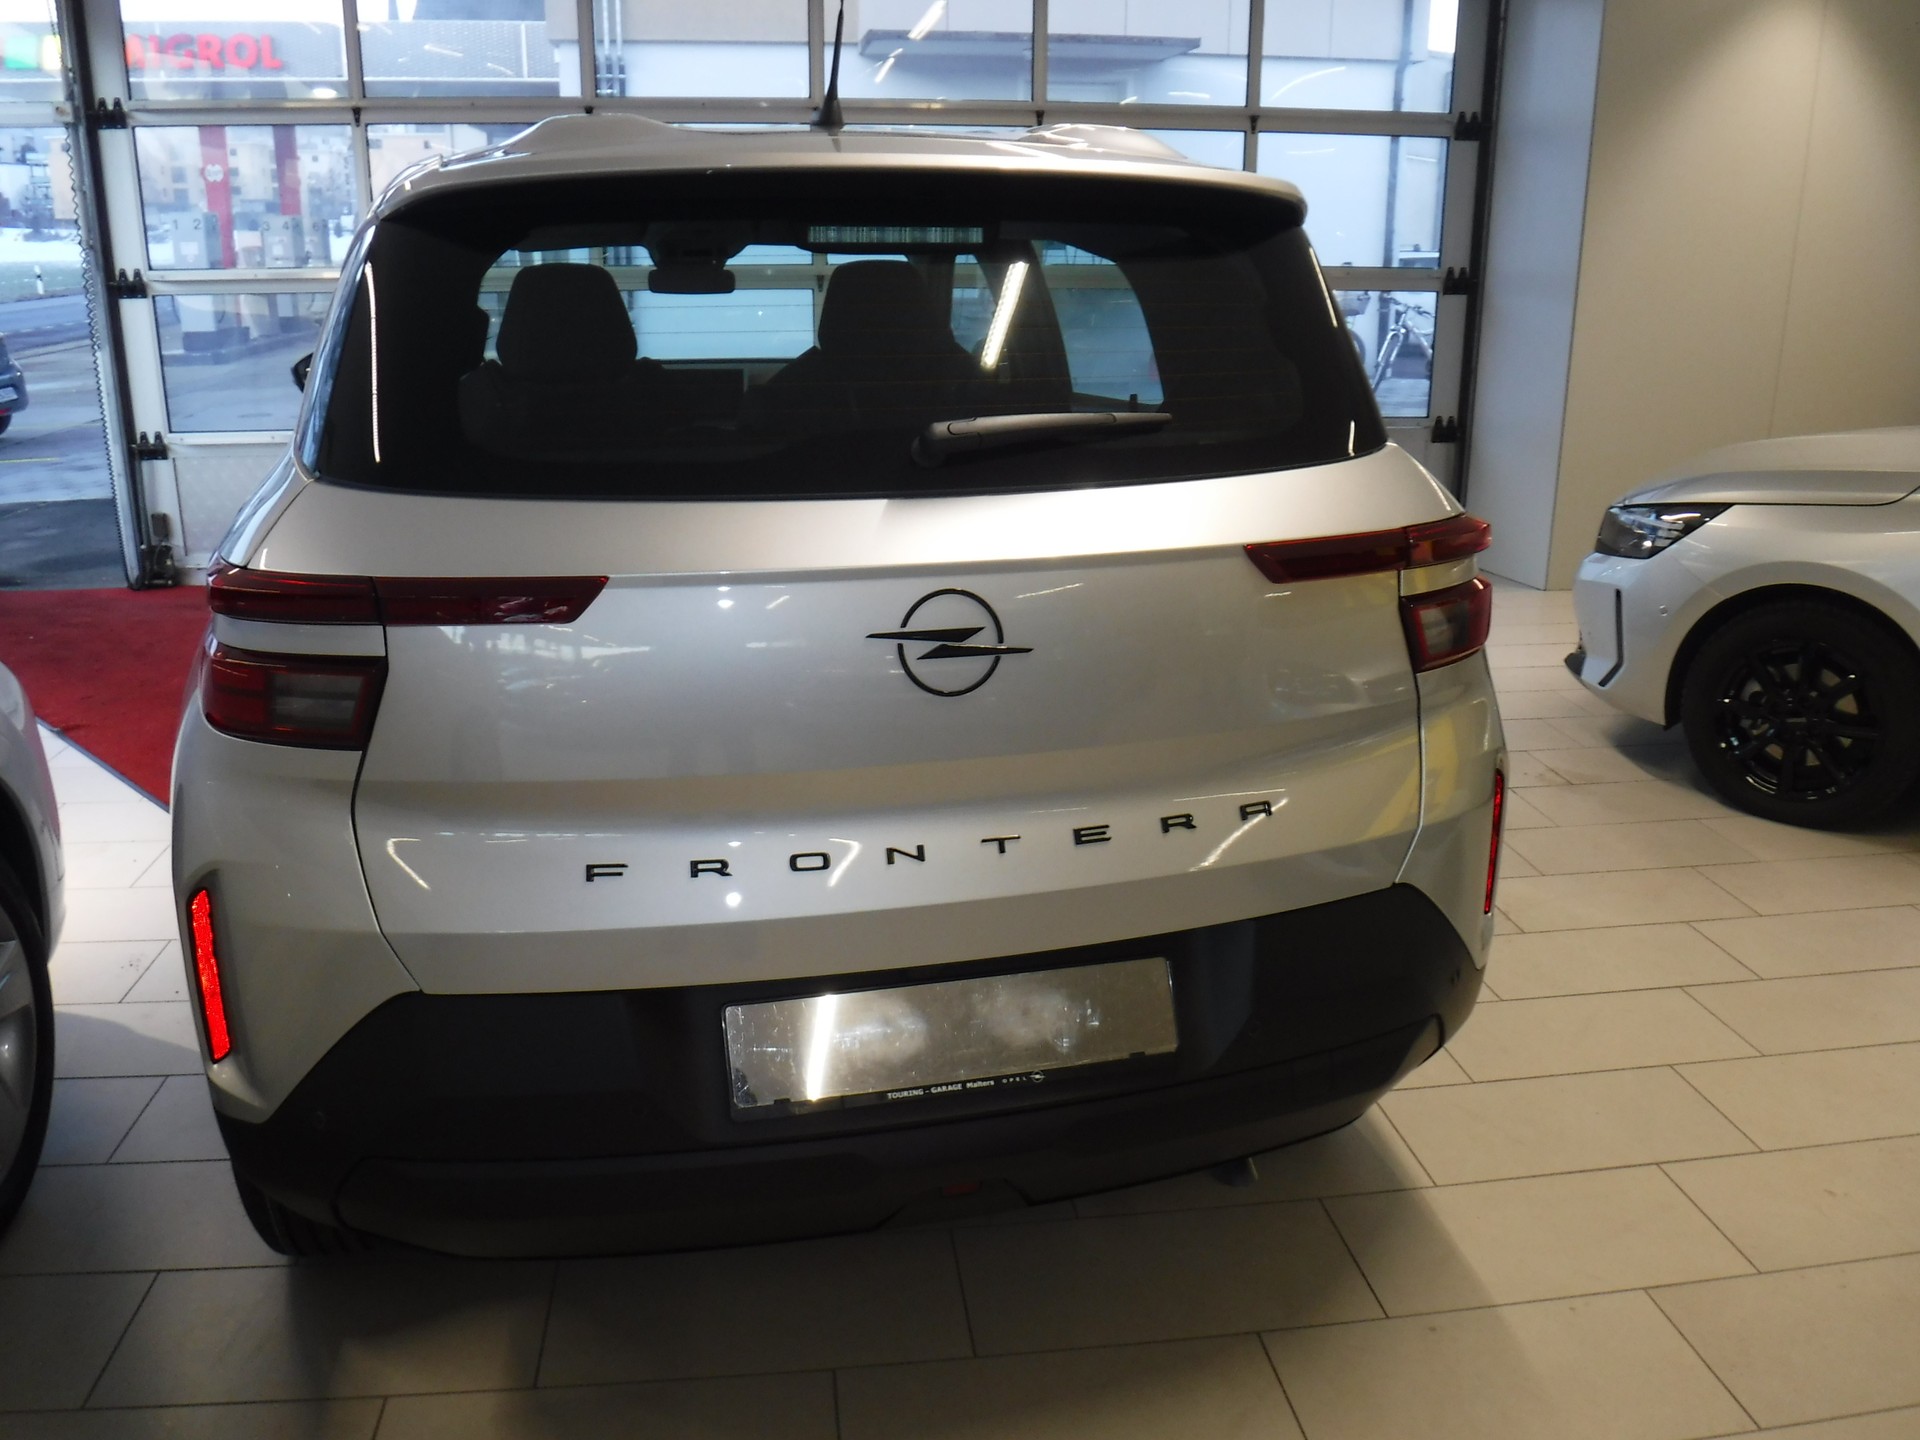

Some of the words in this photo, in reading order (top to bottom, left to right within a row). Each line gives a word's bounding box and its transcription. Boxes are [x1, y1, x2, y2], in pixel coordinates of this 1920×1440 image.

[585, 800, 1273, 883] FRONTERA
[887, 1089, 924, 1099] TOURING
[931, 1083, 962, 1093] GARAGE
